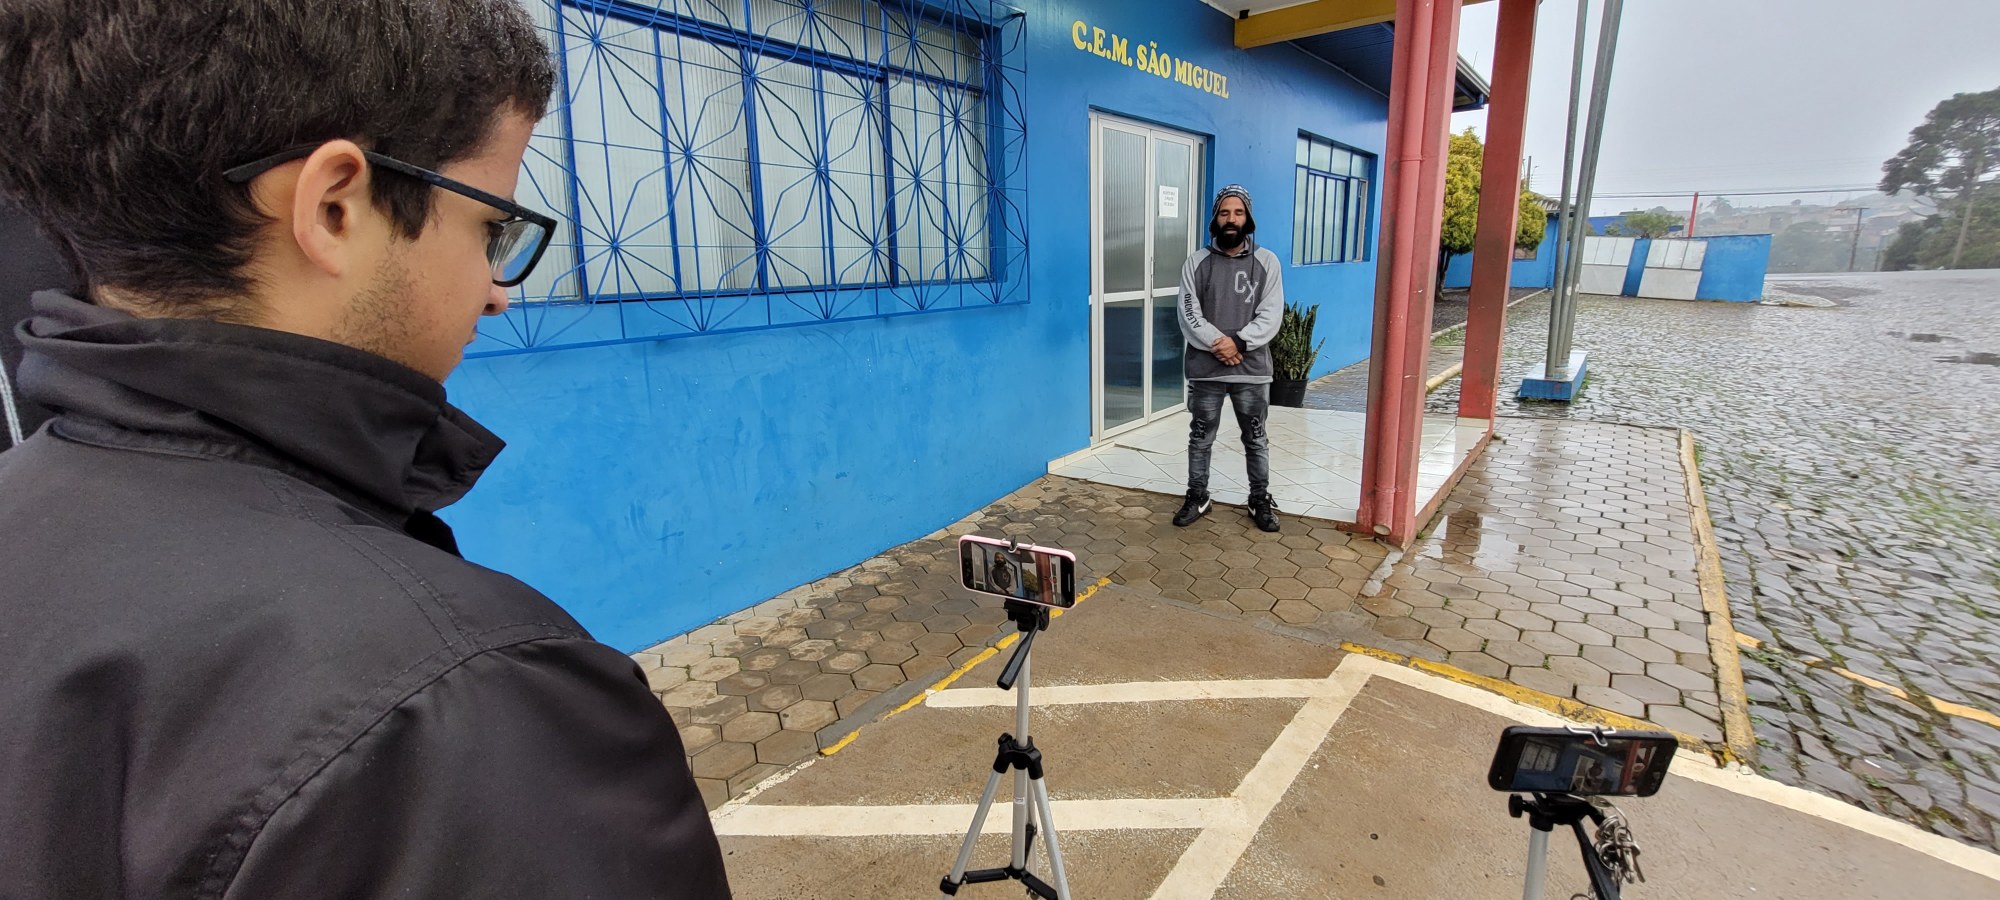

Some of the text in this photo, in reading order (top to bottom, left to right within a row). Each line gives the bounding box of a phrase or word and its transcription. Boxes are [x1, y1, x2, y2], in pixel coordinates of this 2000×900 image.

[1072, 20, 1230, 99] C.E.M. SÃO MIGUEL
